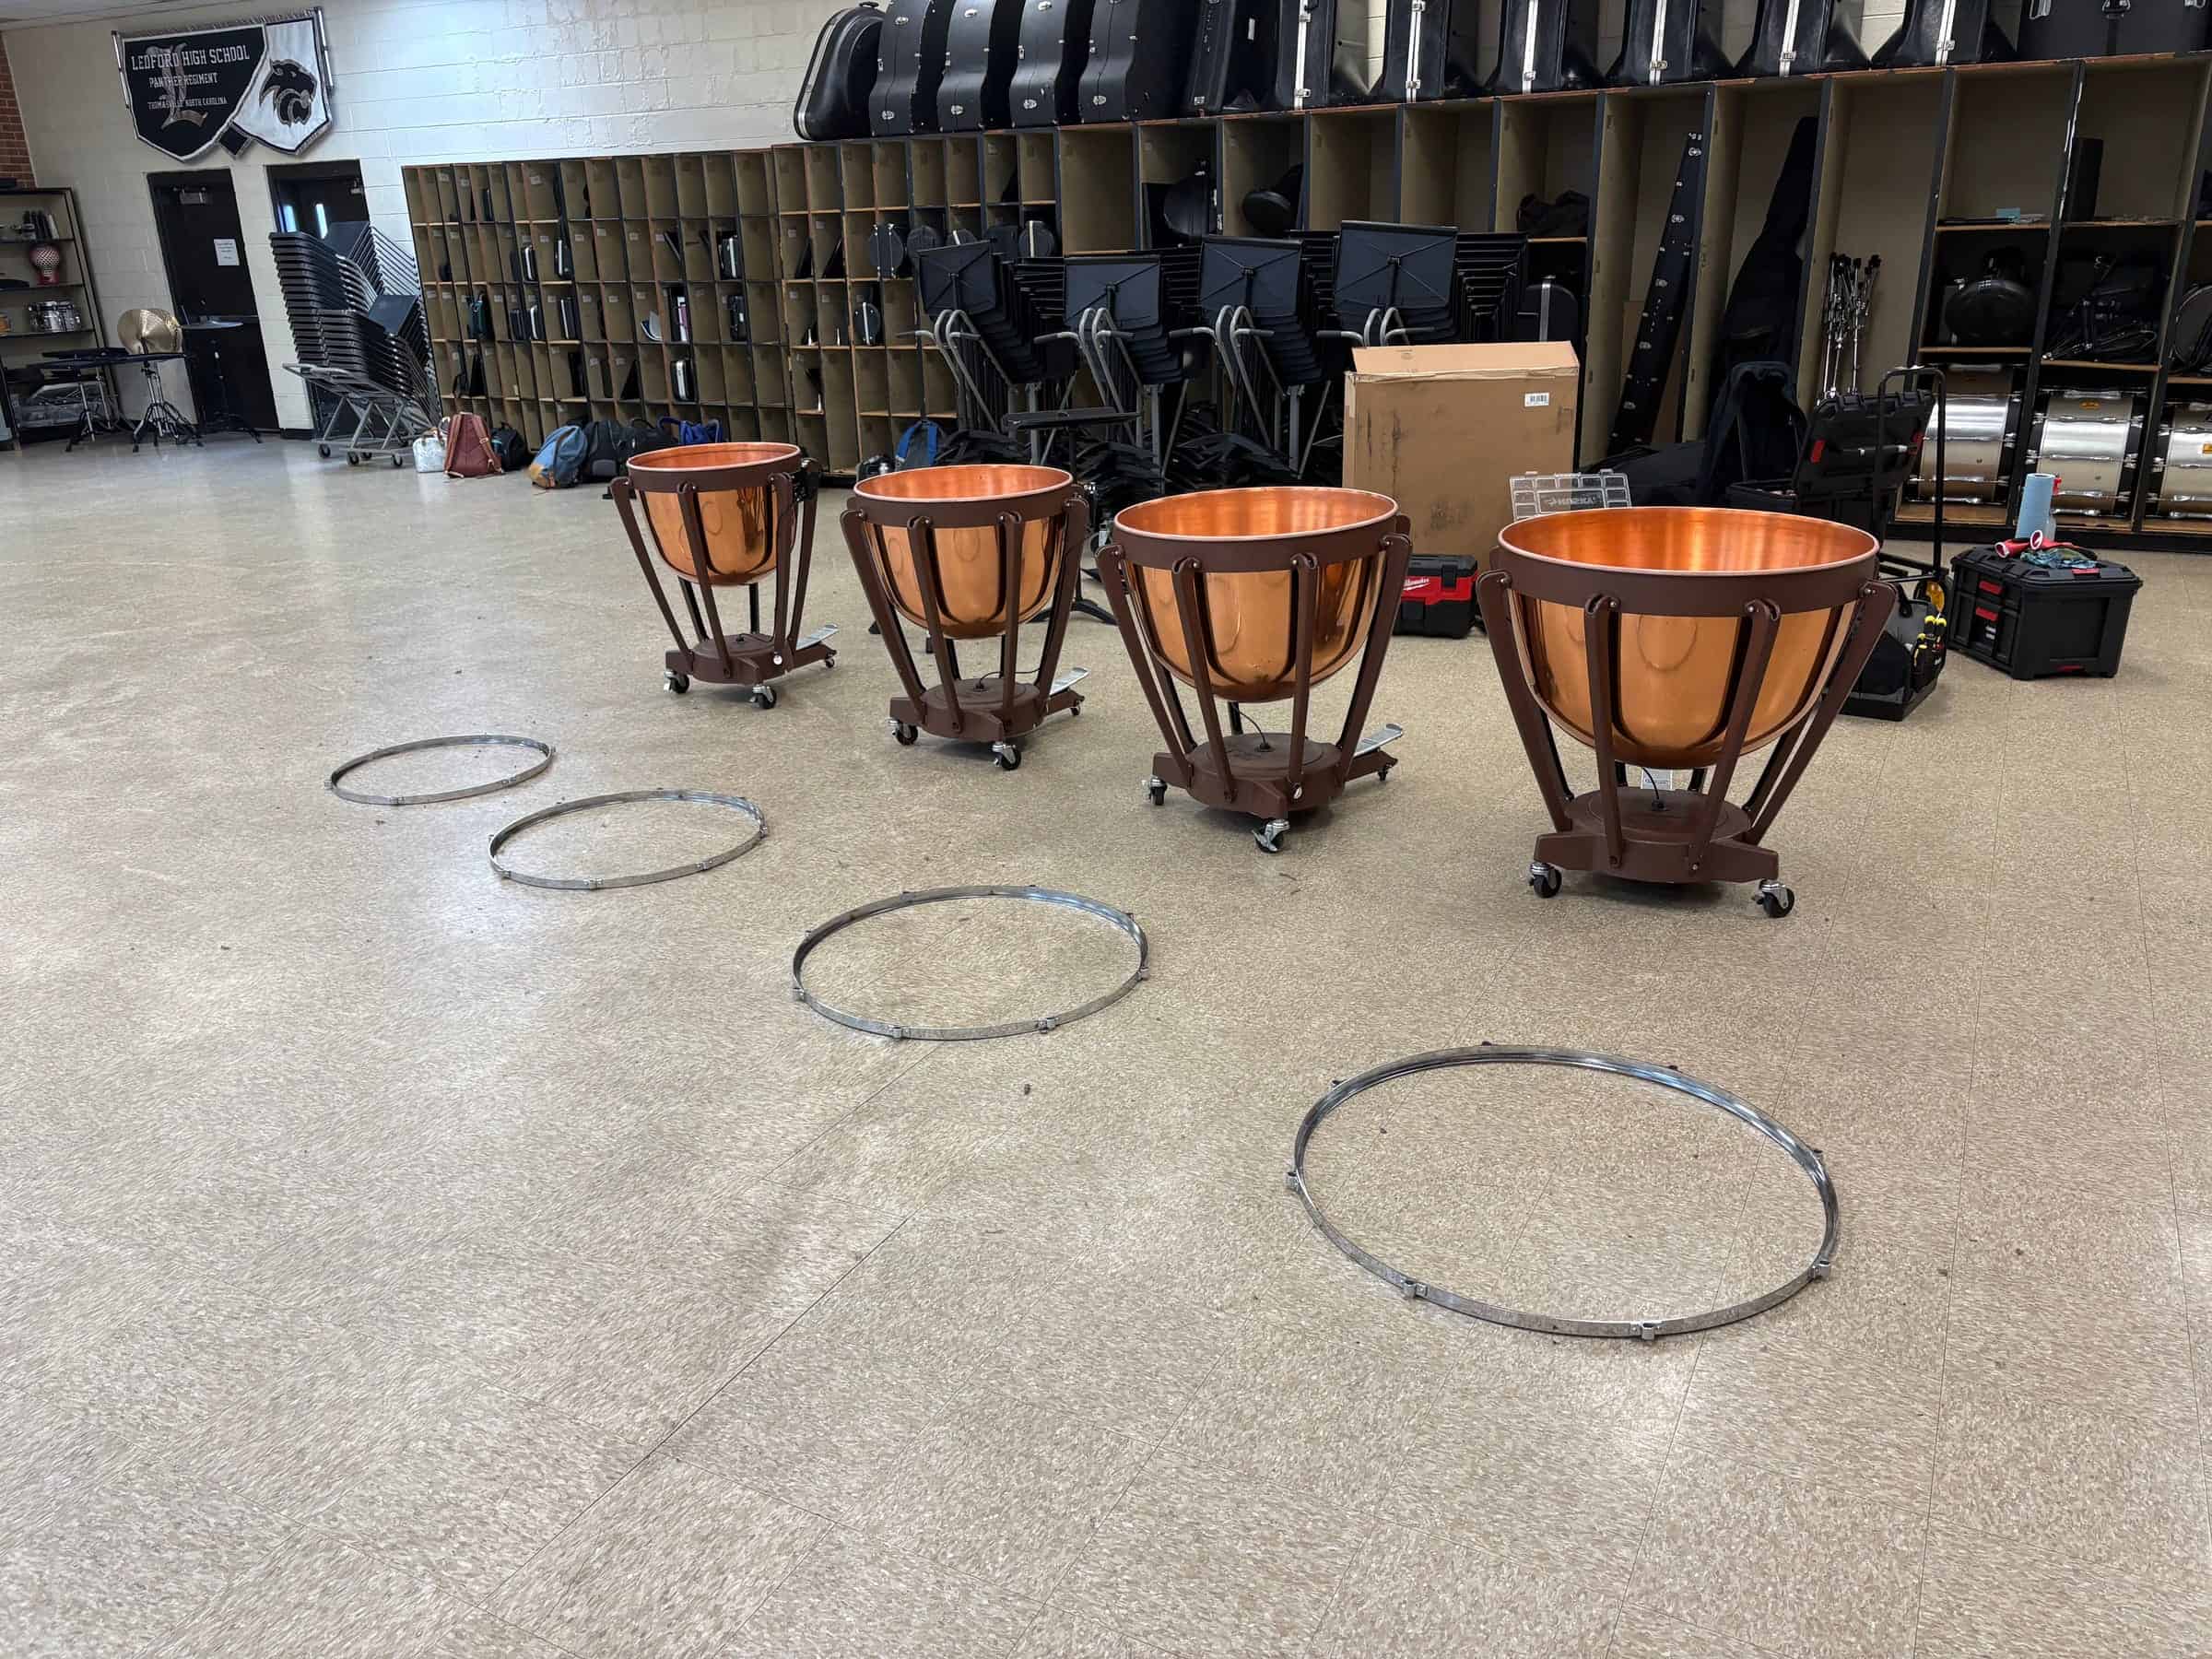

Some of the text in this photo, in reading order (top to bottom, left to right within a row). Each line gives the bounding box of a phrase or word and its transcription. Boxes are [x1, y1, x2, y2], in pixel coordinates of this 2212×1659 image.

[131, 45, 251, 70] LEDFORD HIGH SCHOOL
[148, 72, 218, 88] PANTHER REGIMENT
